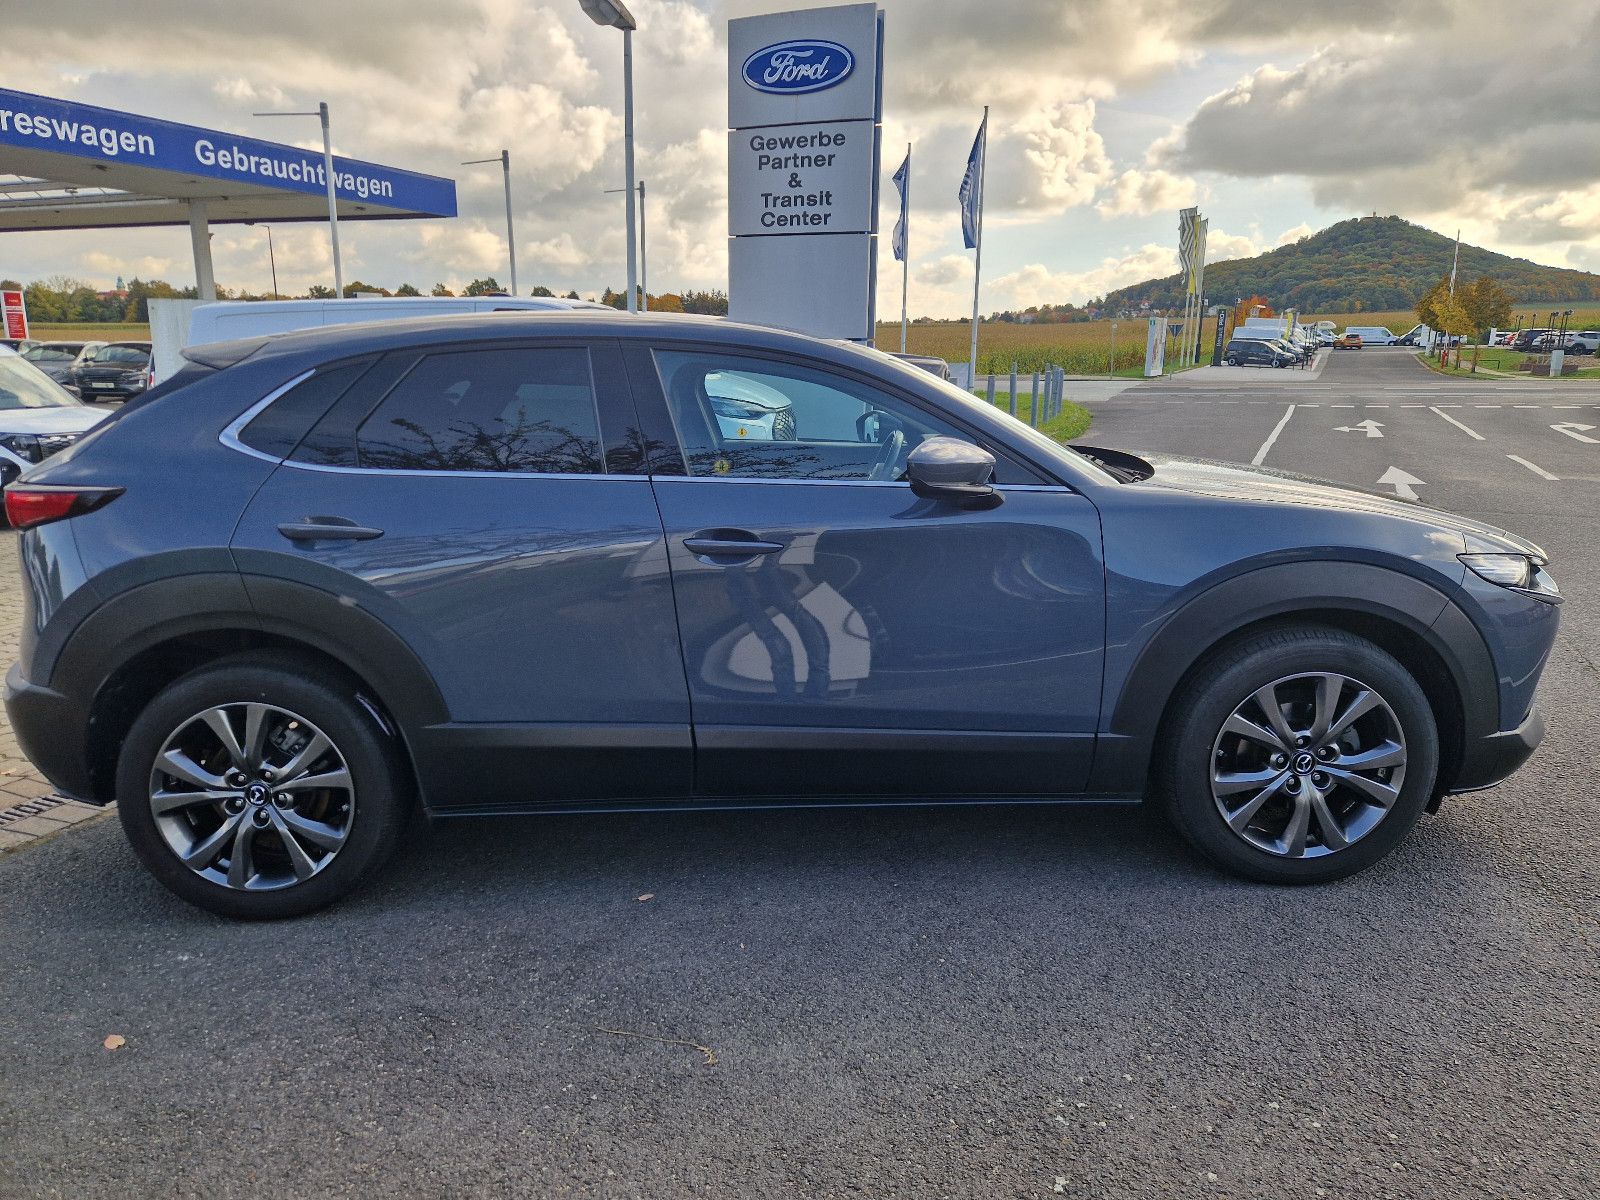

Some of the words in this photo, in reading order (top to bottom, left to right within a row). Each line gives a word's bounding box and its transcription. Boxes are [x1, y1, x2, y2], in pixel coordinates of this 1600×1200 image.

[764, 49, 830, 84] Ford
[0, 110, 156, 156] reswagen
[749, 130, 846, 152] Gewerbe
[757, 152, 836, 171] Partner
[788, 172, 803, 188] &
[760, 189, 833, 209] Transit
[760, 210, 832, 228] Center
